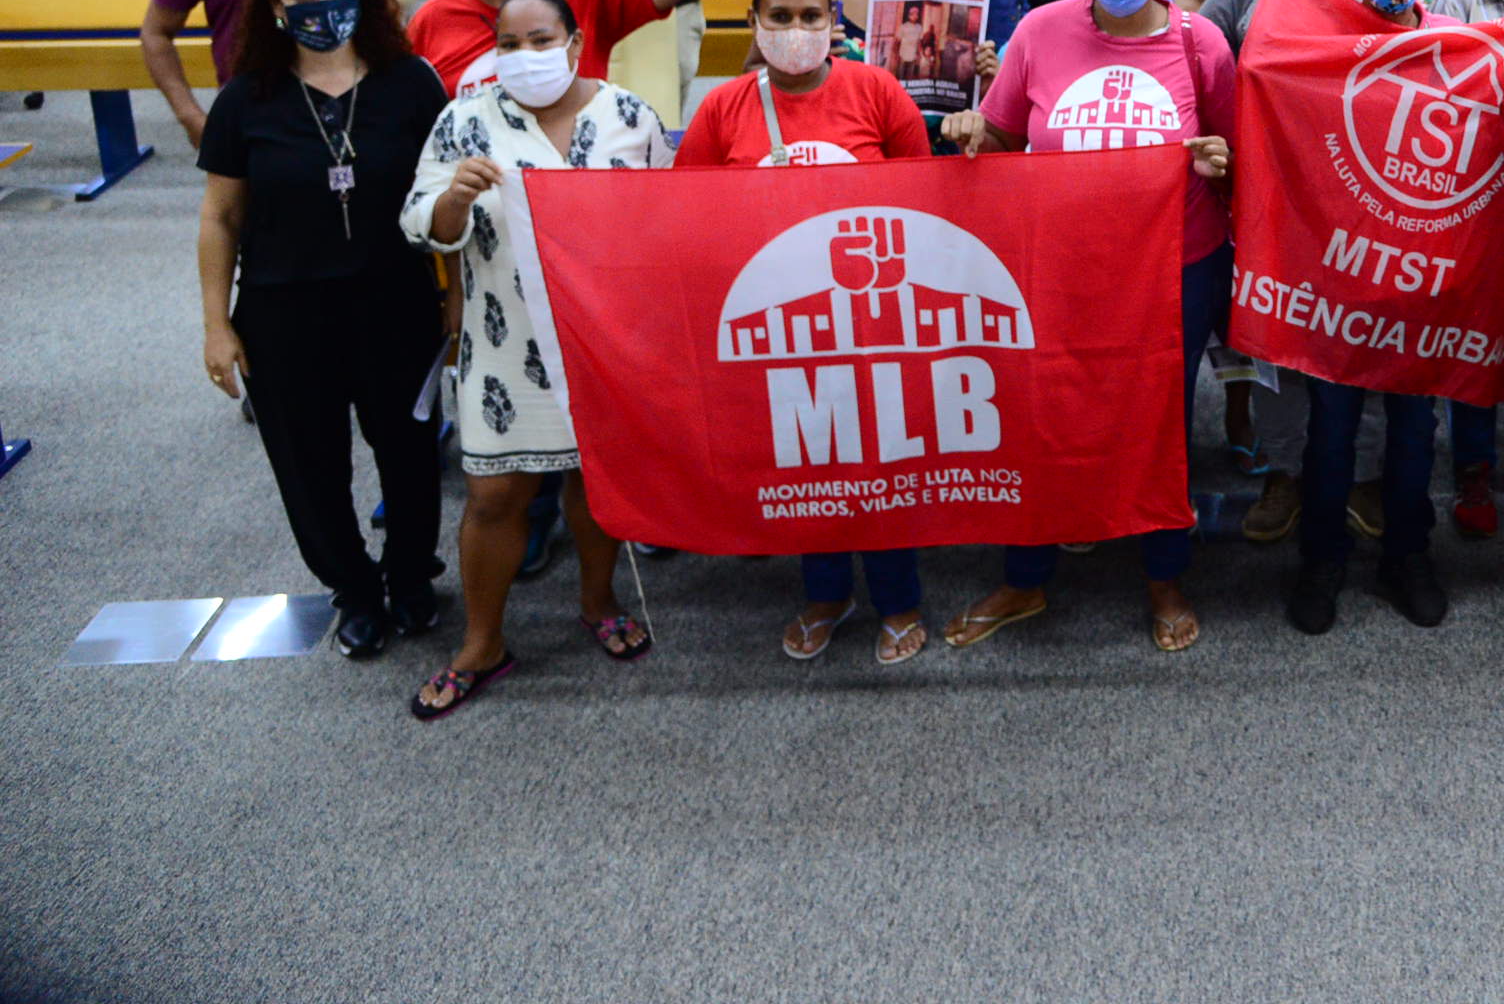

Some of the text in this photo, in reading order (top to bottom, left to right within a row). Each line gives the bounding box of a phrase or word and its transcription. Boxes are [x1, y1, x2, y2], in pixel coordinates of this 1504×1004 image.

[1324, 132, 1341, 158] NA
[1333, 157, 1361, 199] LUTA
[1359, 192, 1395, 226] PELA
[1396, 212, 1463, 234] REFORMA
[1383, 156, 1459, 196] BRASIL
[1321, 227, 1456, 297] MTST
[766, 355, 1002, 469] MLB
[757, 468, 1023, 503] MOVIMENTO DE LUTA NOS
[762, 486, 1022, 520] BAIRROS, VILAS E FAVELAS
